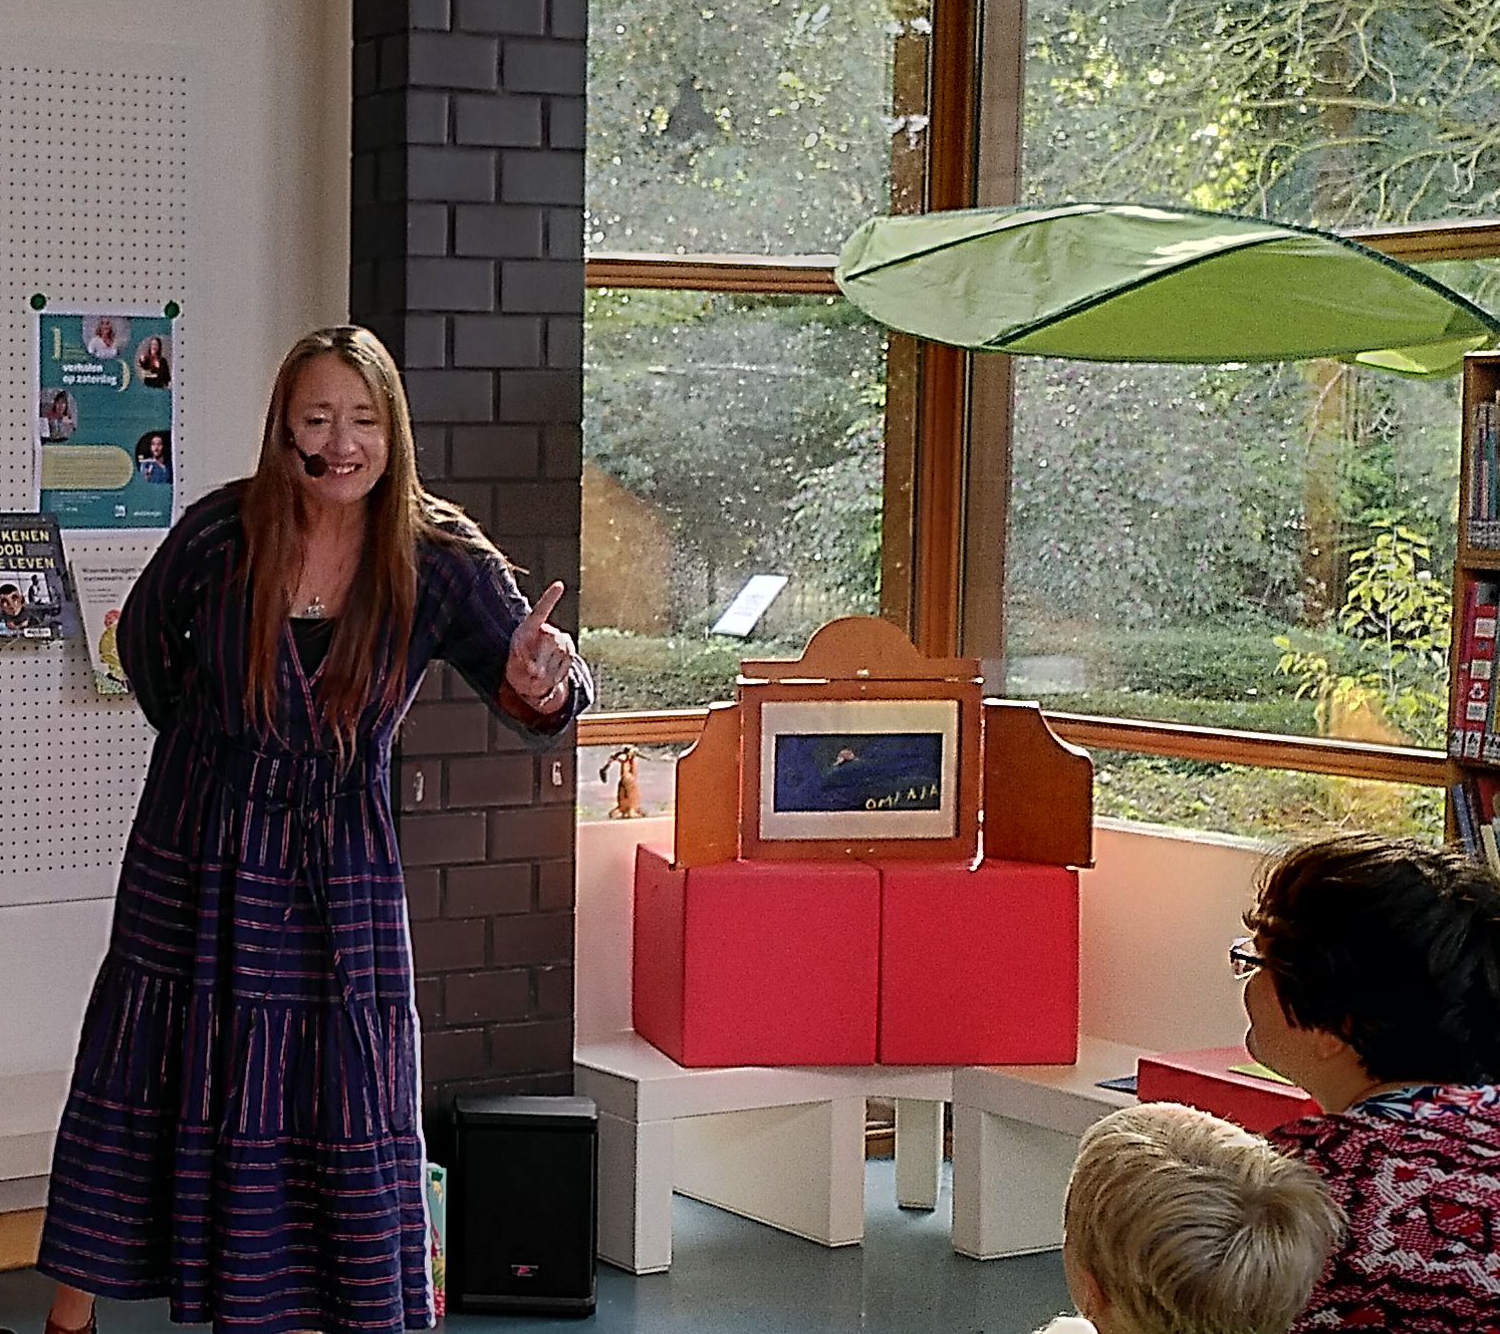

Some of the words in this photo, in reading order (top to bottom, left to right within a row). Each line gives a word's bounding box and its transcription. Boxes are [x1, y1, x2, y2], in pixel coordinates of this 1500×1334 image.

[62, 363, 104, 372] verhalen
[62, 375, 75, 385] op
[76, 374, 118, 386] zaterdag
[8, 558, 55, 569] LEVEN
